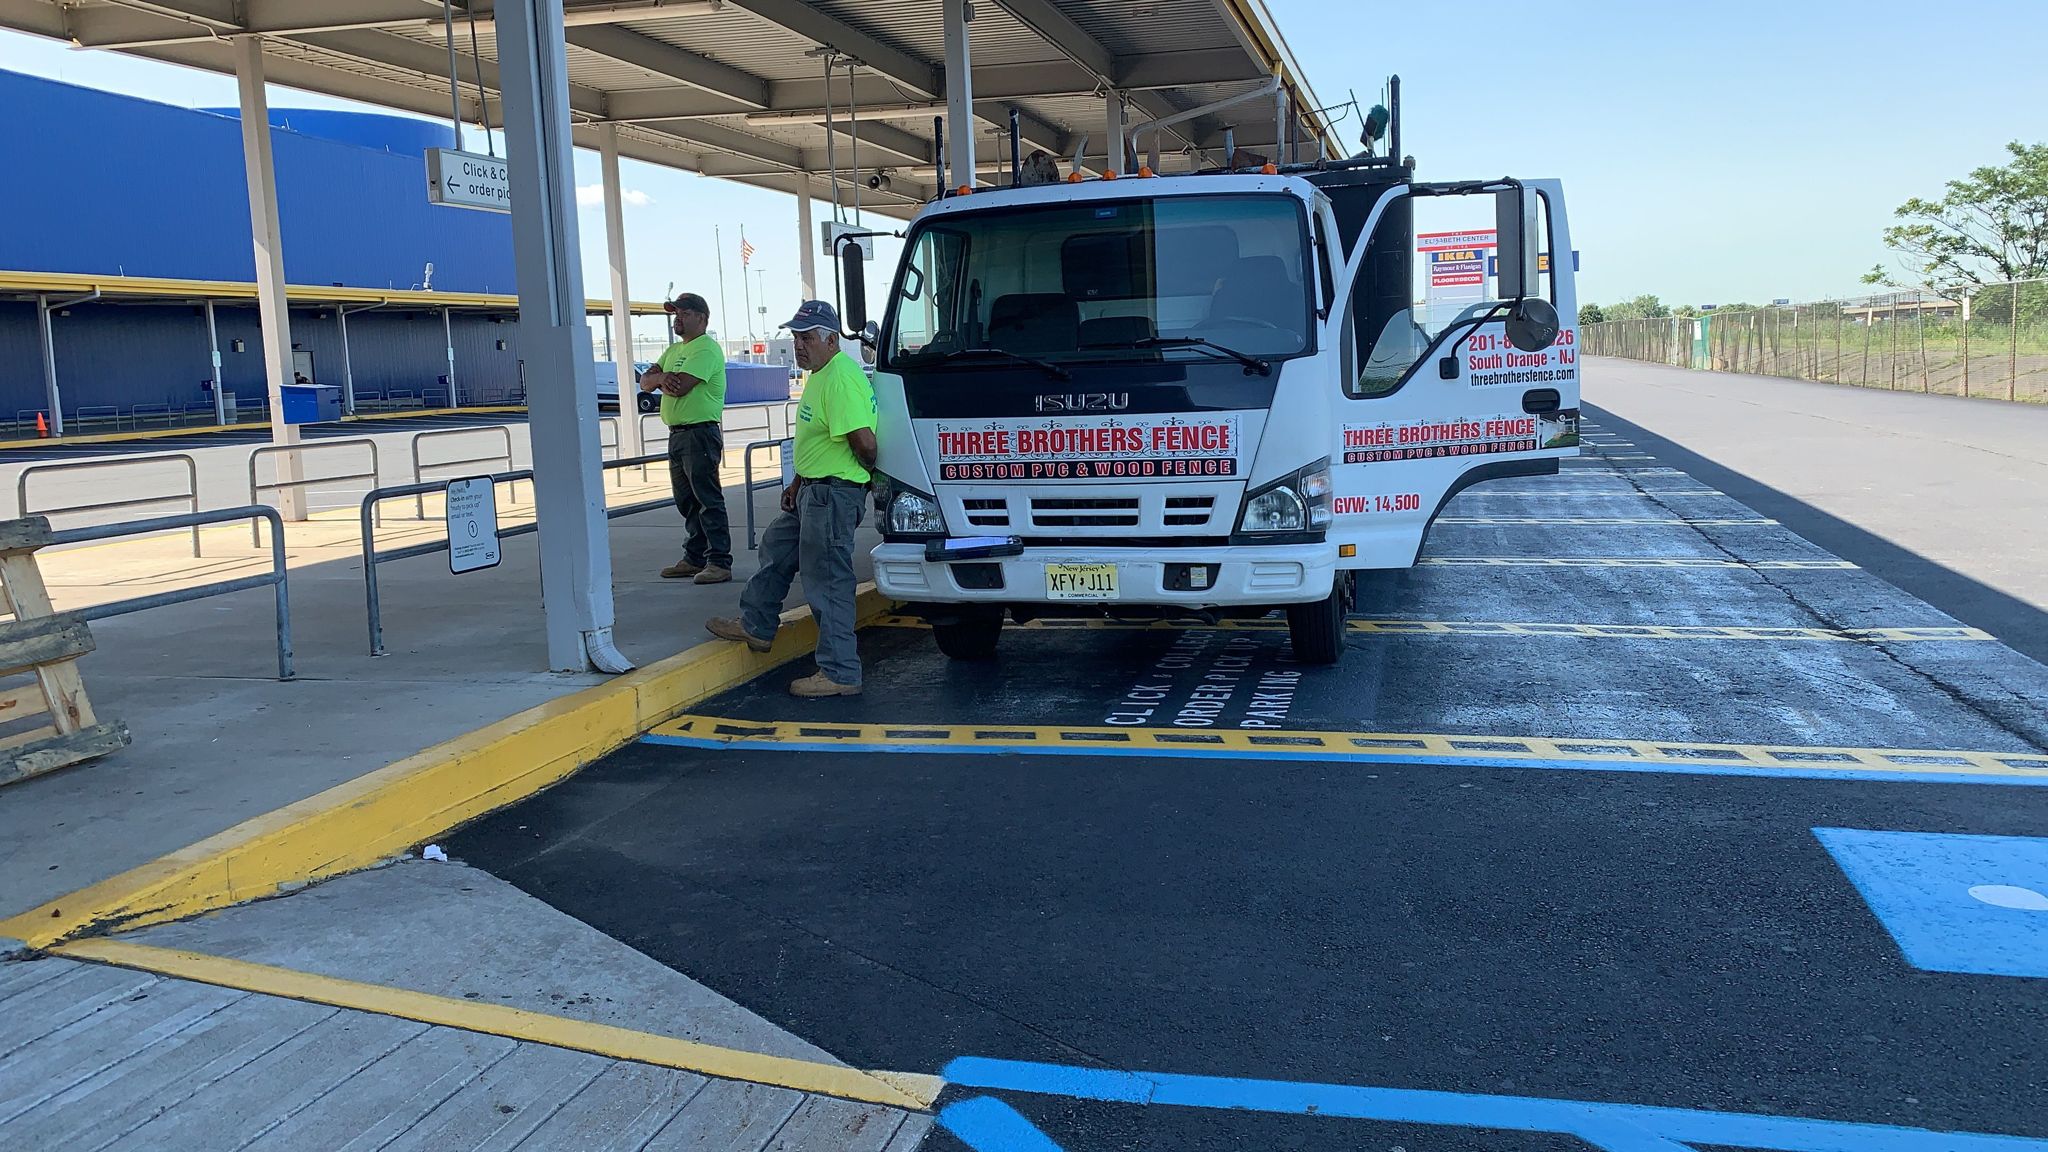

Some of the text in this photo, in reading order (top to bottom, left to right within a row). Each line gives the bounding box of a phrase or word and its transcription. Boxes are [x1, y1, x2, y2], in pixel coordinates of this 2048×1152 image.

[463, 162, 509, 181] Click & C
[468, 183, 494, 197] order
[1462, 234, 1489, 242] CENTER
[1438, 251, 1476, 261] IKEA
[1469, 354, 1502, 371] South
[1506, 352, 1547, 368] Orange
[1559, 349, 1575, 364] NJ
[1471, 368, 1575, 386] threebrothersfence.com
[1035, 392, 1129, 412] ISUZU
[938, 424, 1230, 456] THREE BROTHERS FENCE
[1344, 418, 1535, 447] THREE BROTHERS FENCE
[1347, 440, 1534, 463] CUSTOM PVC & WOOD FENCE
[945, 459, 1231, 479] CUSTOM PVC & WOOD FENCE
[1334, 494, 1421, 514] GVW: 14,500
[1079, 564, 1100, 573] Jersey
[1050, 573, 1114, 591] XFY J11
[1173, 637, 1263, 726] ORDER PICK UP
[1104, 684, 1173, 726] CLICK
[1239, 671, 1302, 728] PARKING
